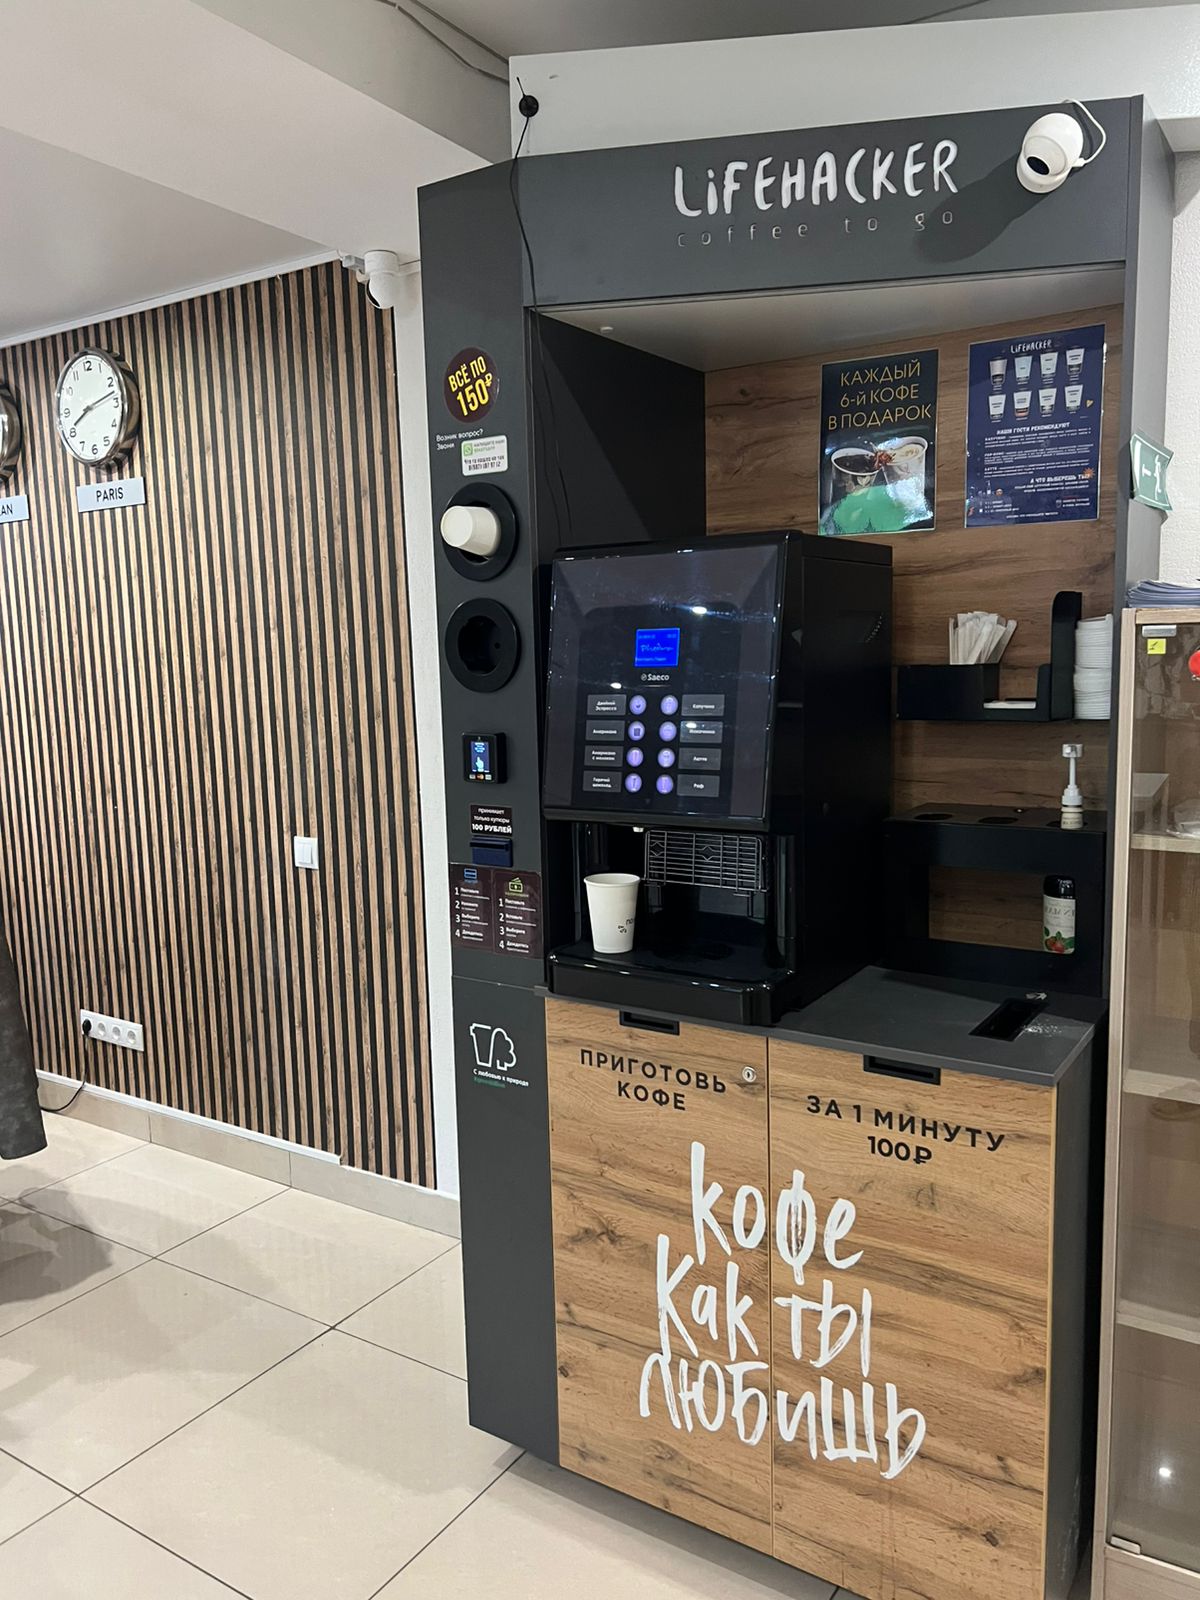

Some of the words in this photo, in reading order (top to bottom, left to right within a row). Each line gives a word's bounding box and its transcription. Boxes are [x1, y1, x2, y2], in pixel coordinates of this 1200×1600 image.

[678, 223, 808, 247] coffee
[844, 216, 878, 233] to
[914, 211, 953, 231] go
[448, 363, 471, 392] ВСЁ
[470, 356, 487, 379] ПО
[840, 358, 920, 386] КАЖДЫЙ
[870, 383, 919, 404] КОФЕ
[828, 415, 837, 431] В
[841, 403, 932, 429] ПОДАРОК
[96, 486, 124, 502] PARIS
[647, 673, 670, 681] Saeco
[472, 823, 483, 831] 100
[484, 825, 512, 834] РУБЛЕЙ
[580, 1048, 726, 1093] ПРИГОТОВЬ
[617, 1080, 686, 1111] КОФЕ
[807, 1095, 842, 1119] ЗА
[853, 1104, 862, 1123] 1
[874, 1108, 1005, 1152] МИНУТУ
